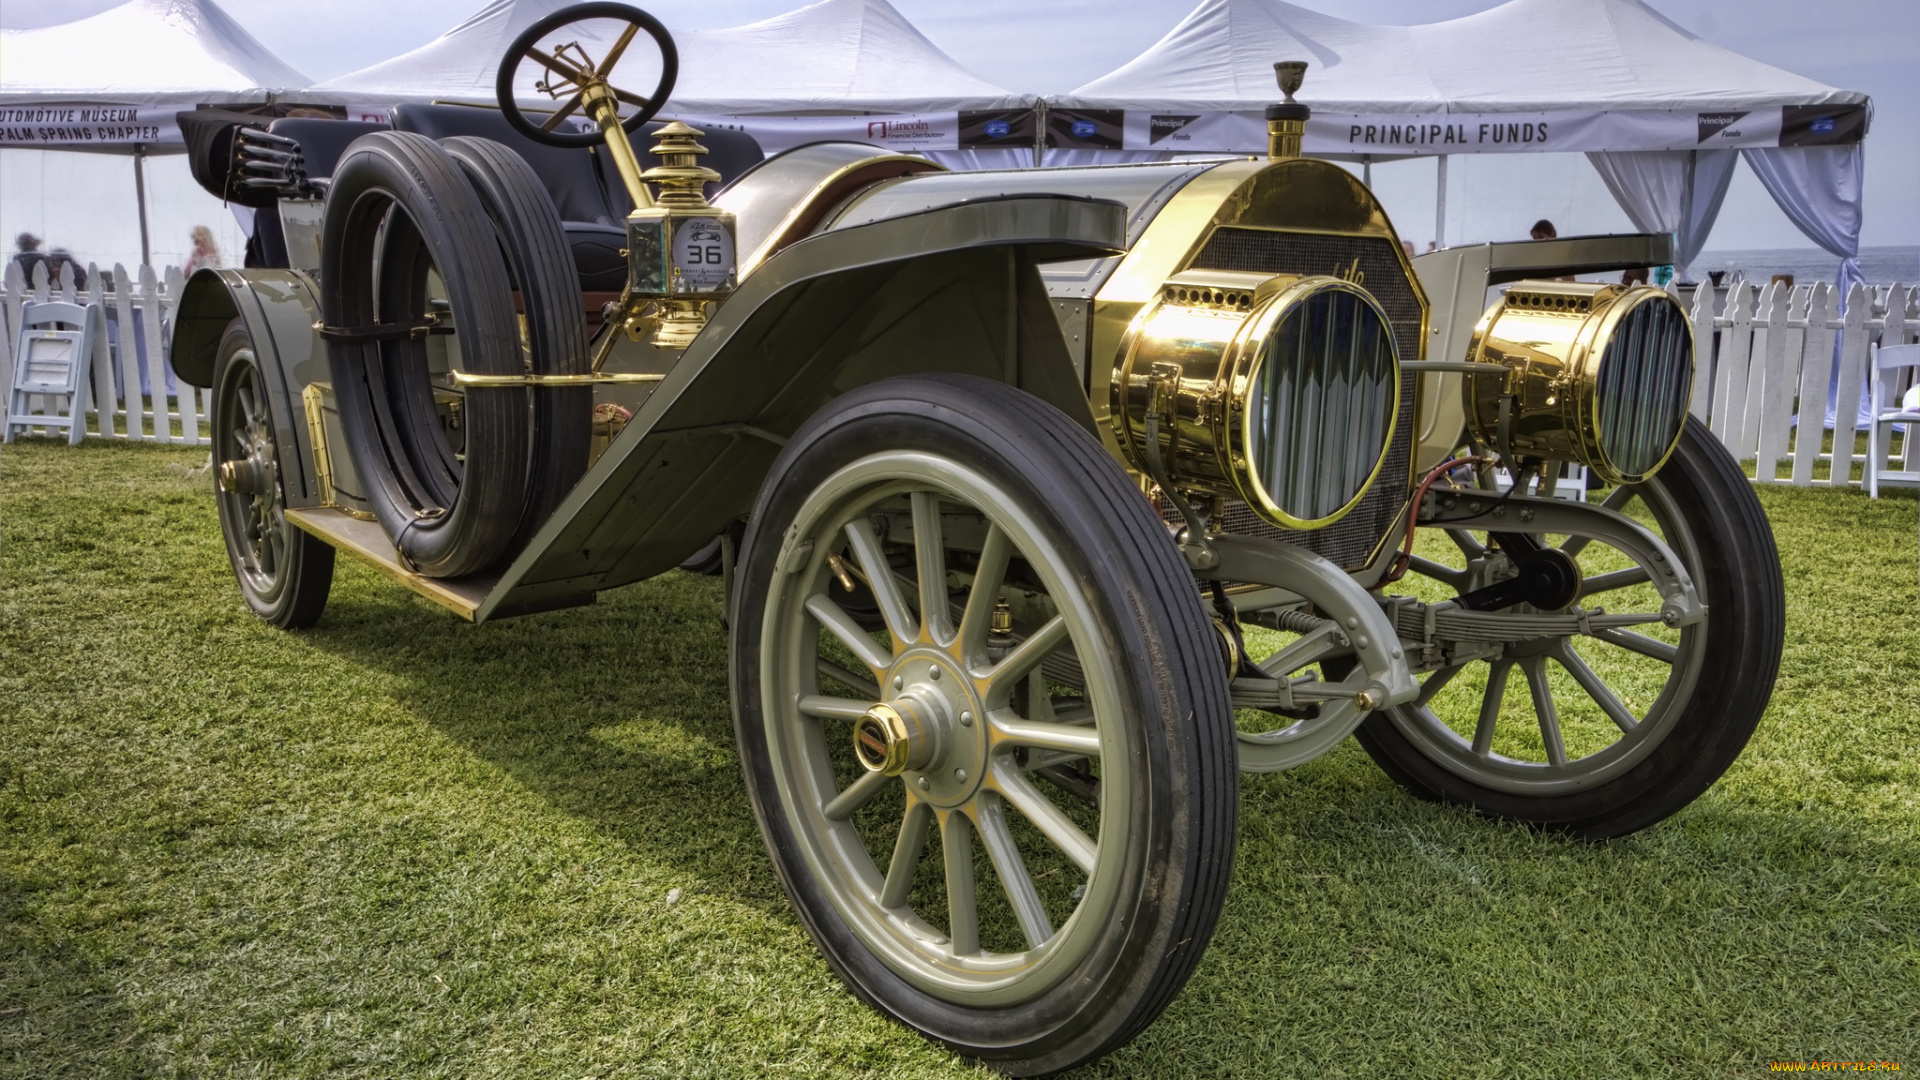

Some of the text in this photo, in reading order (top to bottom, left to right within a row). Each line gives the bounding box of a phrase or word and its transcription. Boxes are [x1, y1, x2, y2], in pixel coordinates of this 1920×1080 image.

[80, 109, 138, 122] MUSEUM
[1699, 117, 1734, 125] Principal
[888, 120, 928, 130] Lincoln
[1151, 119, 1185, 128] Principal
[0, 126, 159, 141] PALM SPRING CHAPTER
[1349, 122, 1548, 144] PRINCIPAL FUNDS
[687, 245, 721, 264] 36
